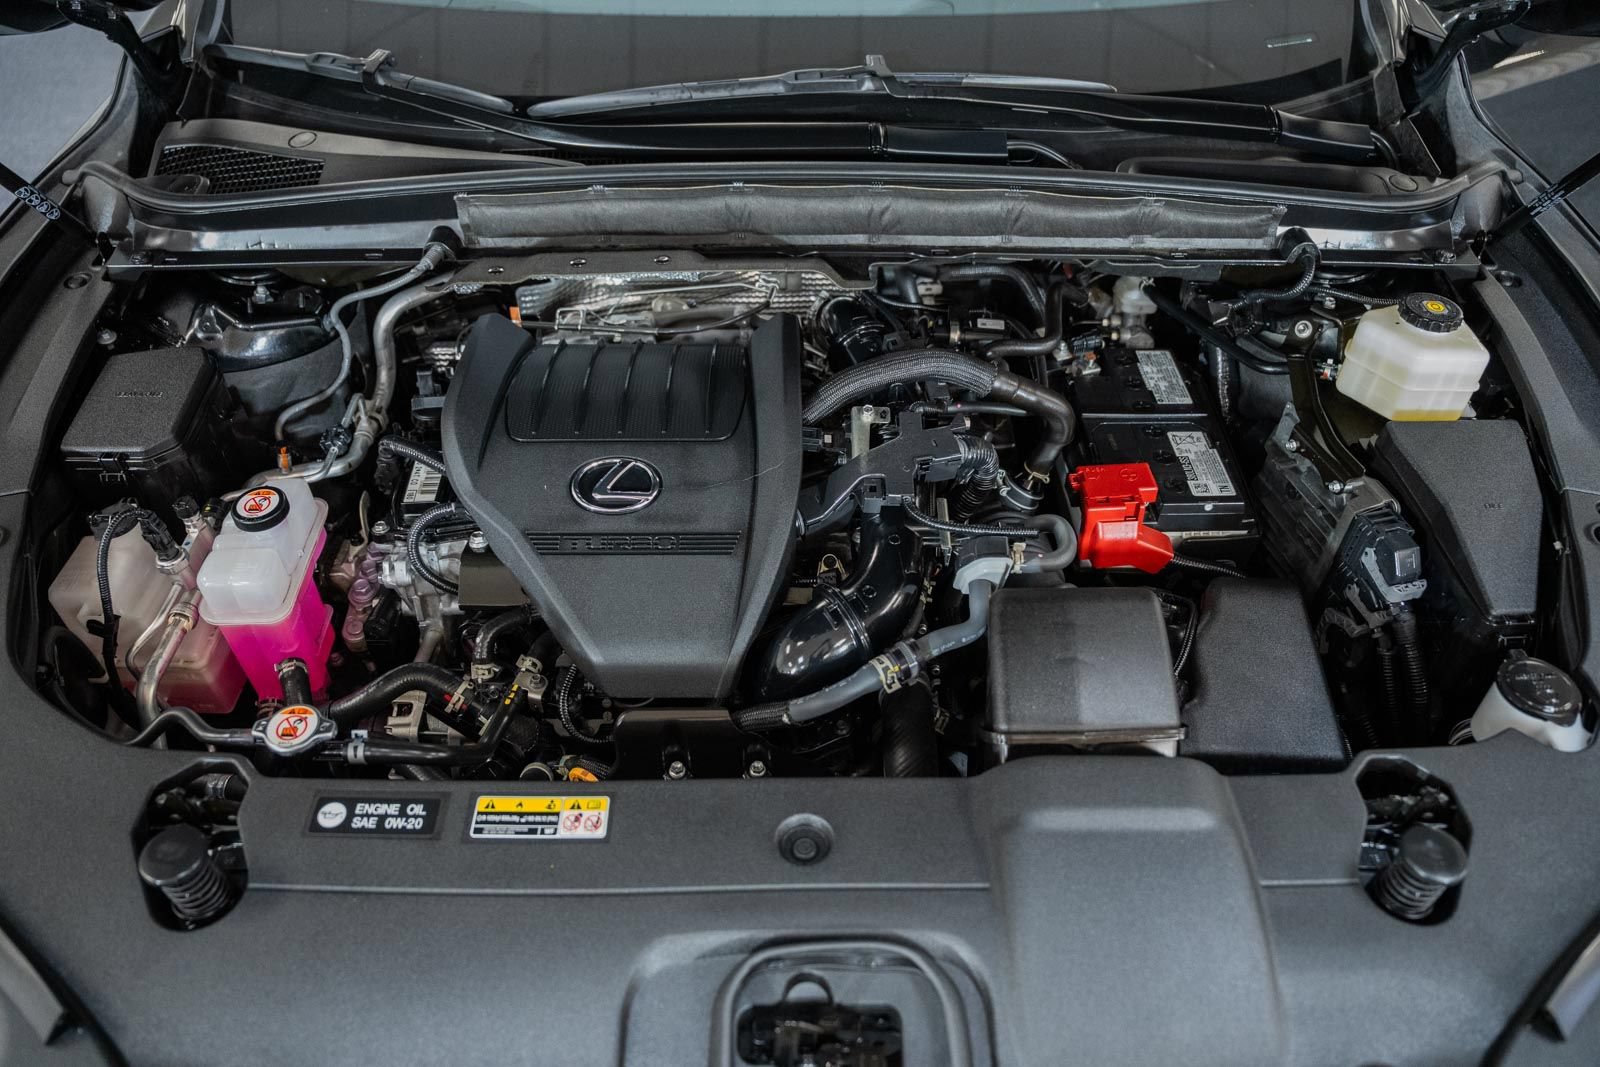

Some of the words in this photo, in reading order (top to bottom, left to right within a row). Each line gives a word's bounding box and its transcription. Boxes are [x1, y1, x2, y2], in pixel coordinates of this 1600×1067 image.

[562, 535, 677, 550] TURBO
[354, 803, 401, 815] ENGINE
[406, 804, 427, 815] OIL
[350, 816, 379, 829] SAE
[384, 817, 424, 829] 0W-20
